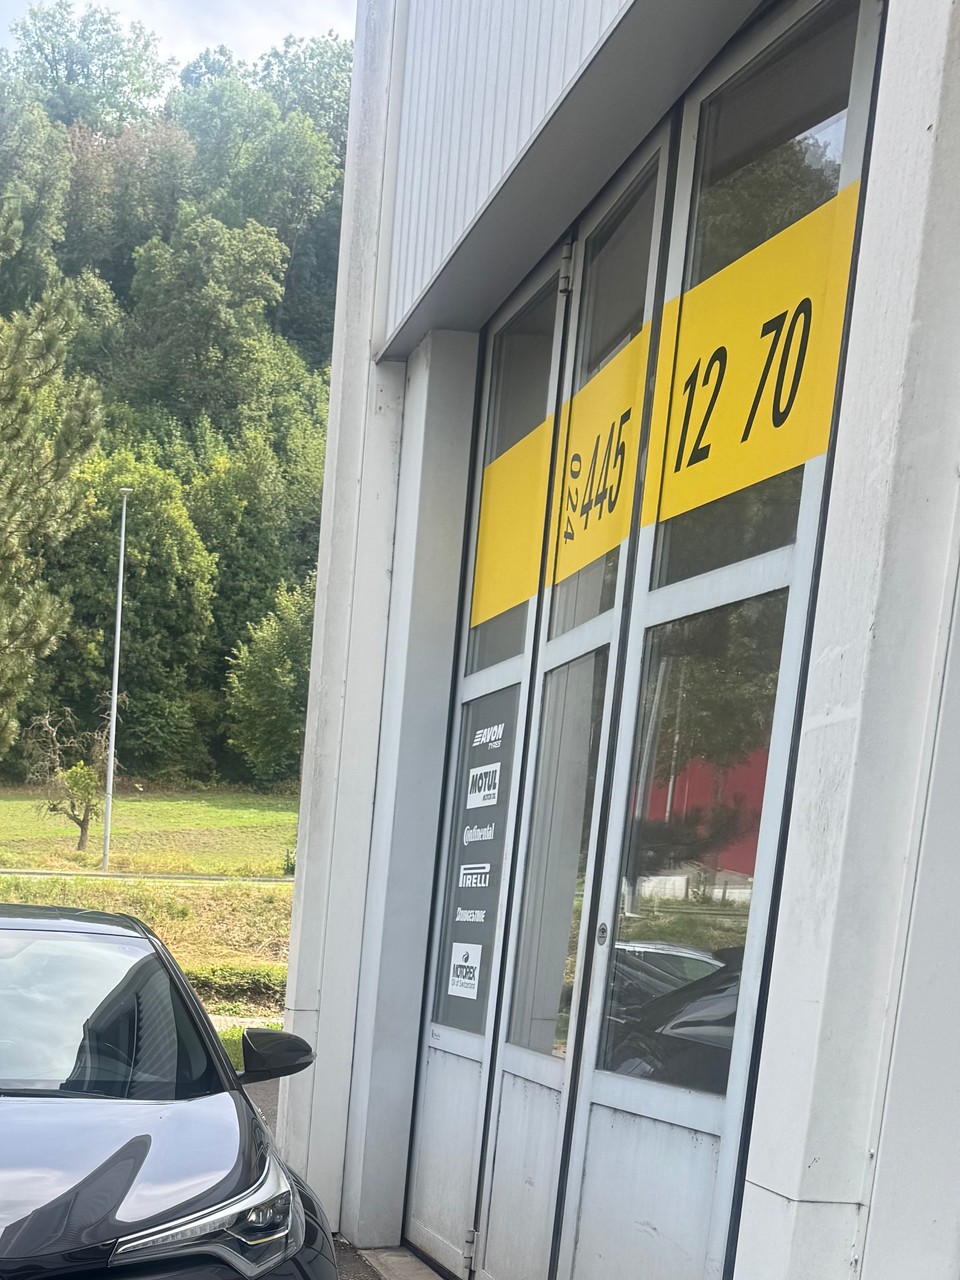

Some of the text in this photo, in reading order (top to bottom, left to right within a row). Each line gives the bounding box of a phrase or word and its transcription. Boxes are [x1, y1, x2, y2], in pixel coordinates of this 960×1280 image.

[564, 297, 813, 545] 024 445 12 70
[480, 722, 505, 745] AVON
[469, 769, 497, 795] MOTUL
[463, 822, 495, 846] Continental
[458, 863, 491, 888] PIRELLI
